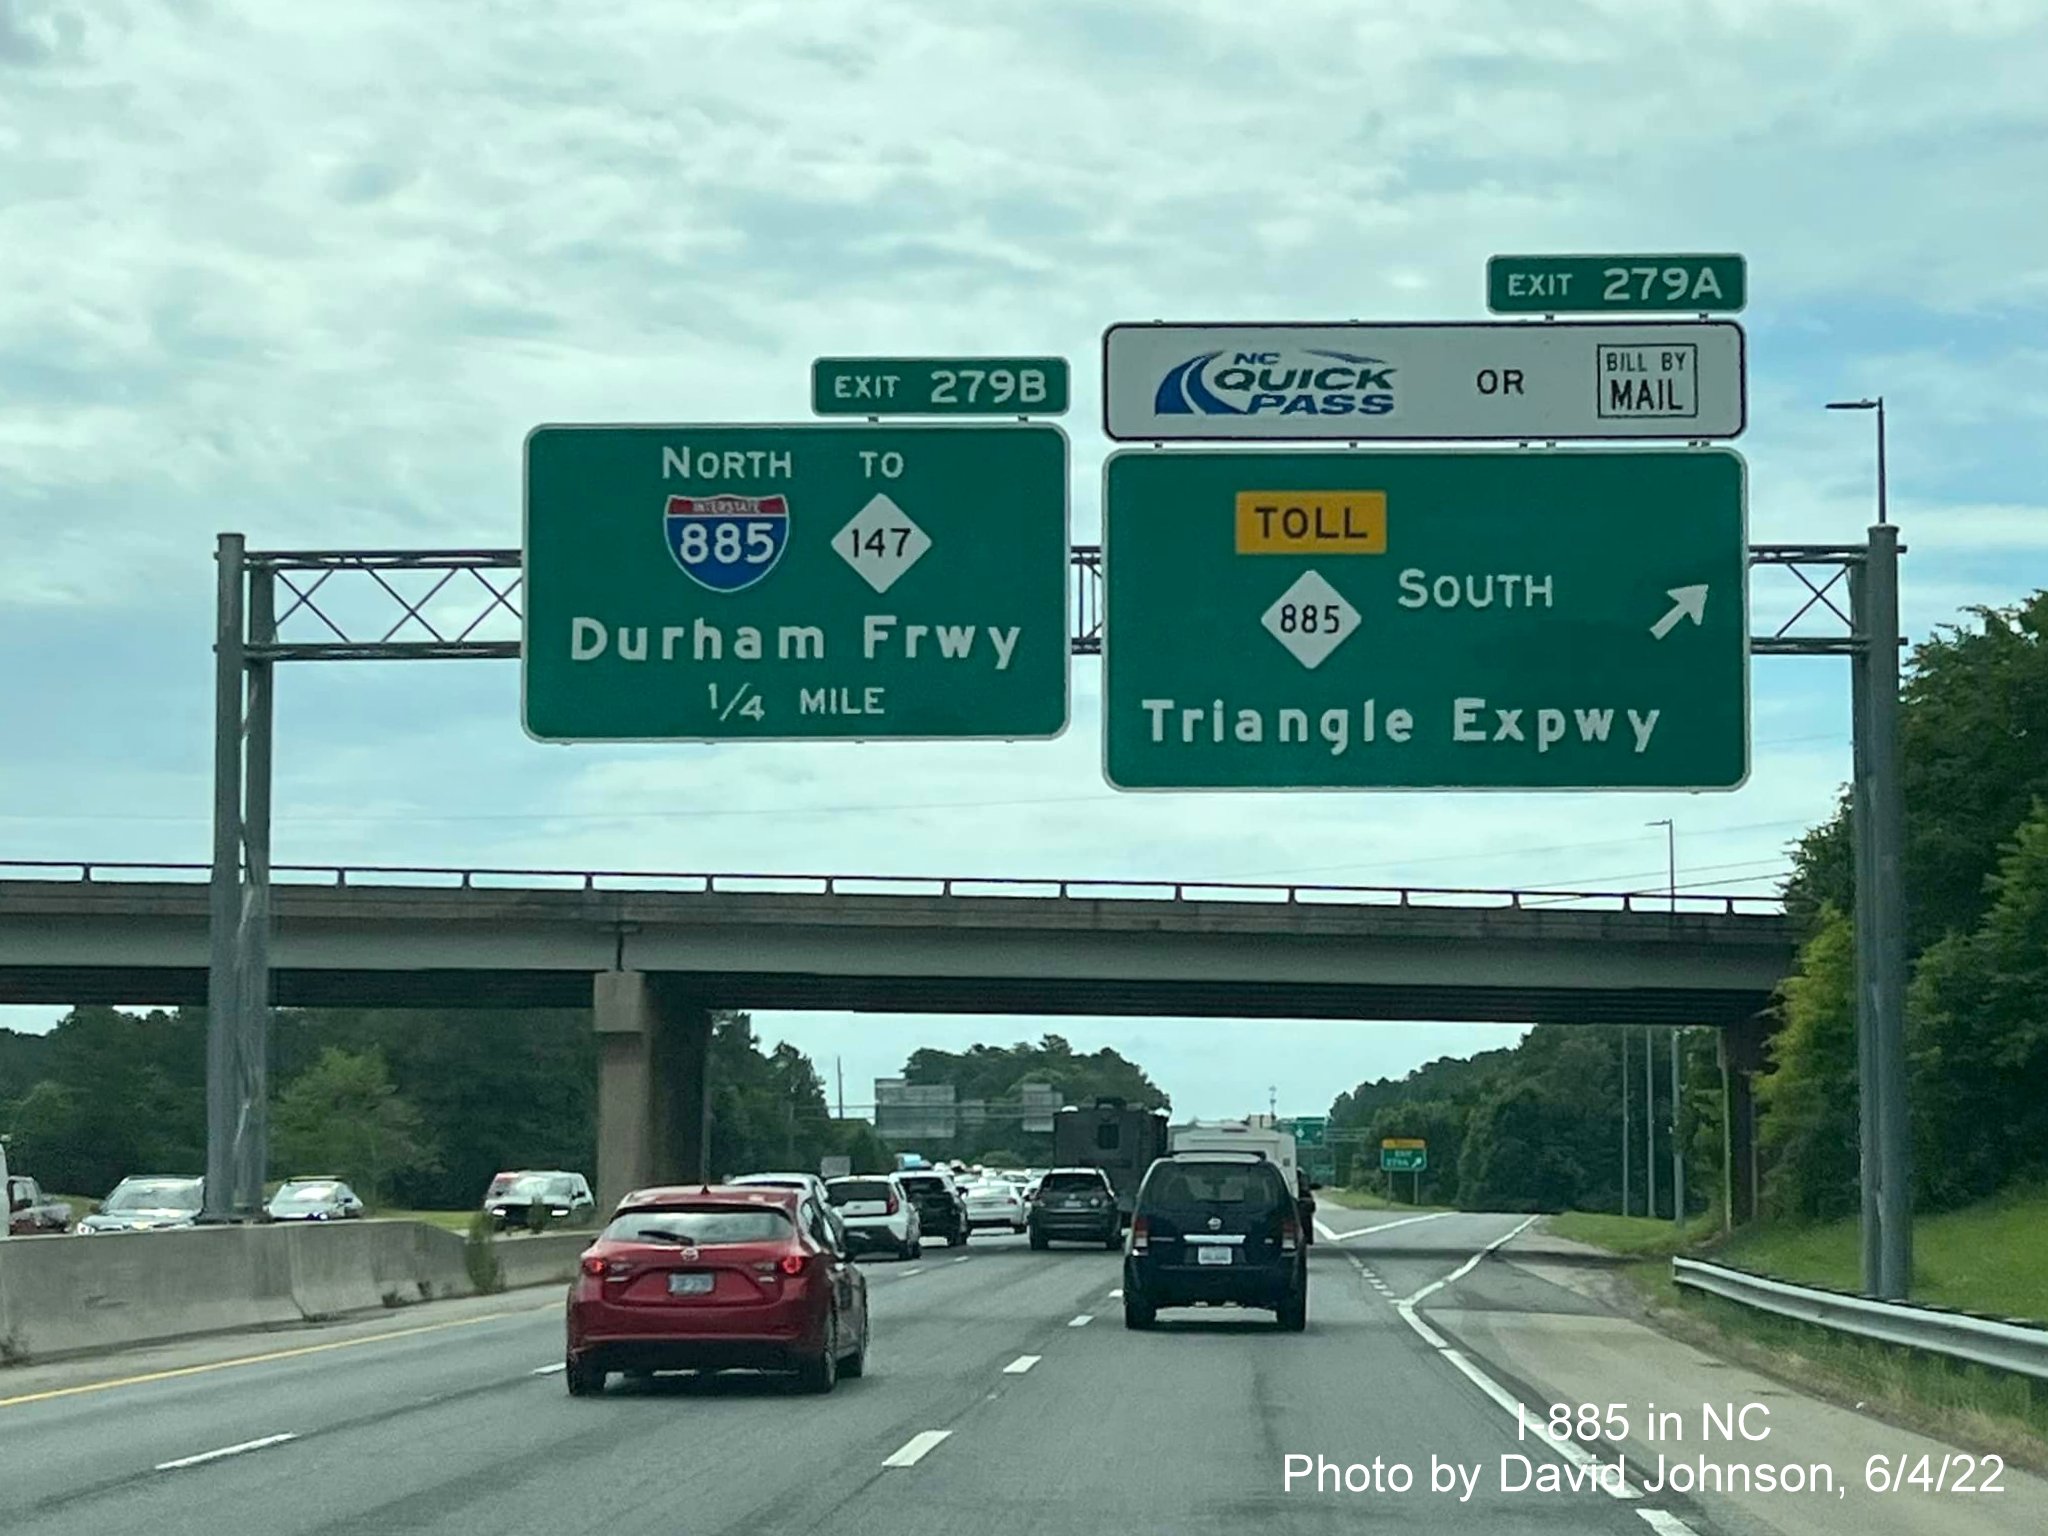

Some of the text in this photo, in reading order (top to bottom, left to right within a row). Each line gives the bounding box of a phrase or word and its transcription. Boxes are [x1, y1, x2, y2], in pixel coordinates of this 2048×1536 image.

[1507, 267, 1723, 302] EXIT 279A
[1233, 352, 1280, 366] NC
[1607, 350, 1687, 373] BILL BY
[834, 371, 1047, 403] EXIT 279B
[1213, 367, 1398, 391] QUICK
[1477, 370, 1524, 395] OR
[1248, 393, 1395, 415] PASS
[1610, 379, 1684, 411] MAIL
[860, 452, 904, 478] TO
[1254, 507, 1368, 539] TOLL
[680, 522, 773, 564] 885
[851, 528, 911, 558] 147
[1280, 605, 1340, 634] 885
[571, 615, 1021, 670] Durham Frwy
[709, 682, 885, 721] 1/4 MILE
[1142, 698, 1661, 754] Triangle Expwy
